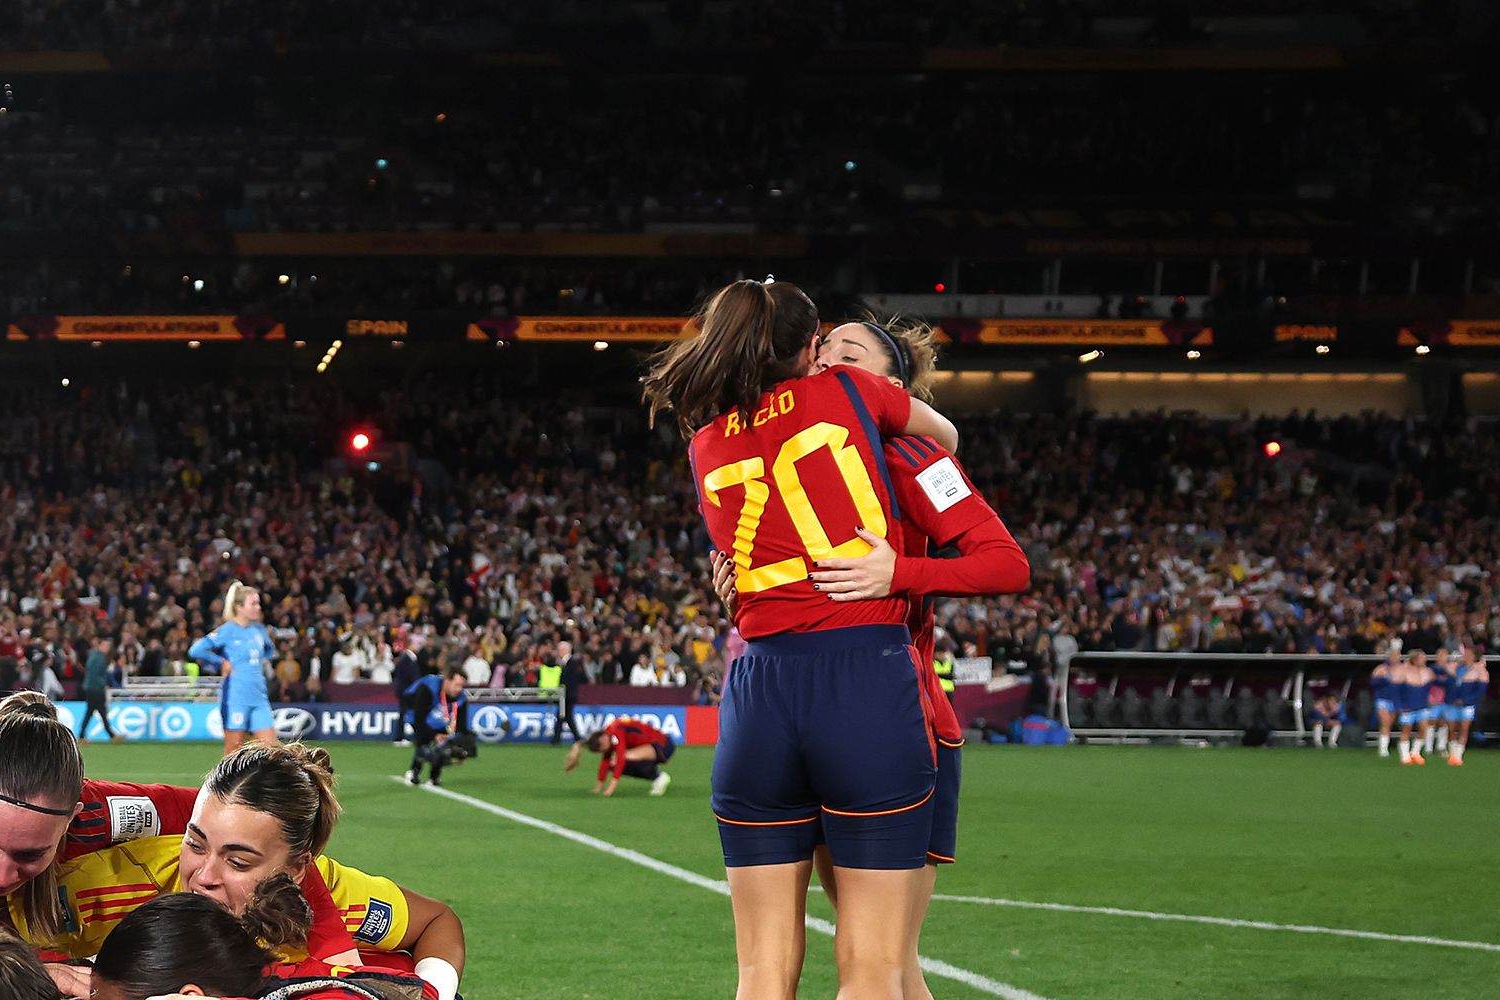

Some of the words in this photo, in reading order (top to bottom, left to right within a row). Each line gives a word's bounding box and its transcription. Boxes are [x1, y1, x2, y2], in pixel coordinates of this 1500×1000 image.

[72, 322, 220, 335] CONGRATULATIONS
[346, 320, 408, 336] SPAIN
[999, 325, 1147, 338] CONGRATULATIONS
[1274, 325, 1338, 341] SPAIN
[703, 421, 887, 593] 20
[125, 804, 136, 834] UNITES
